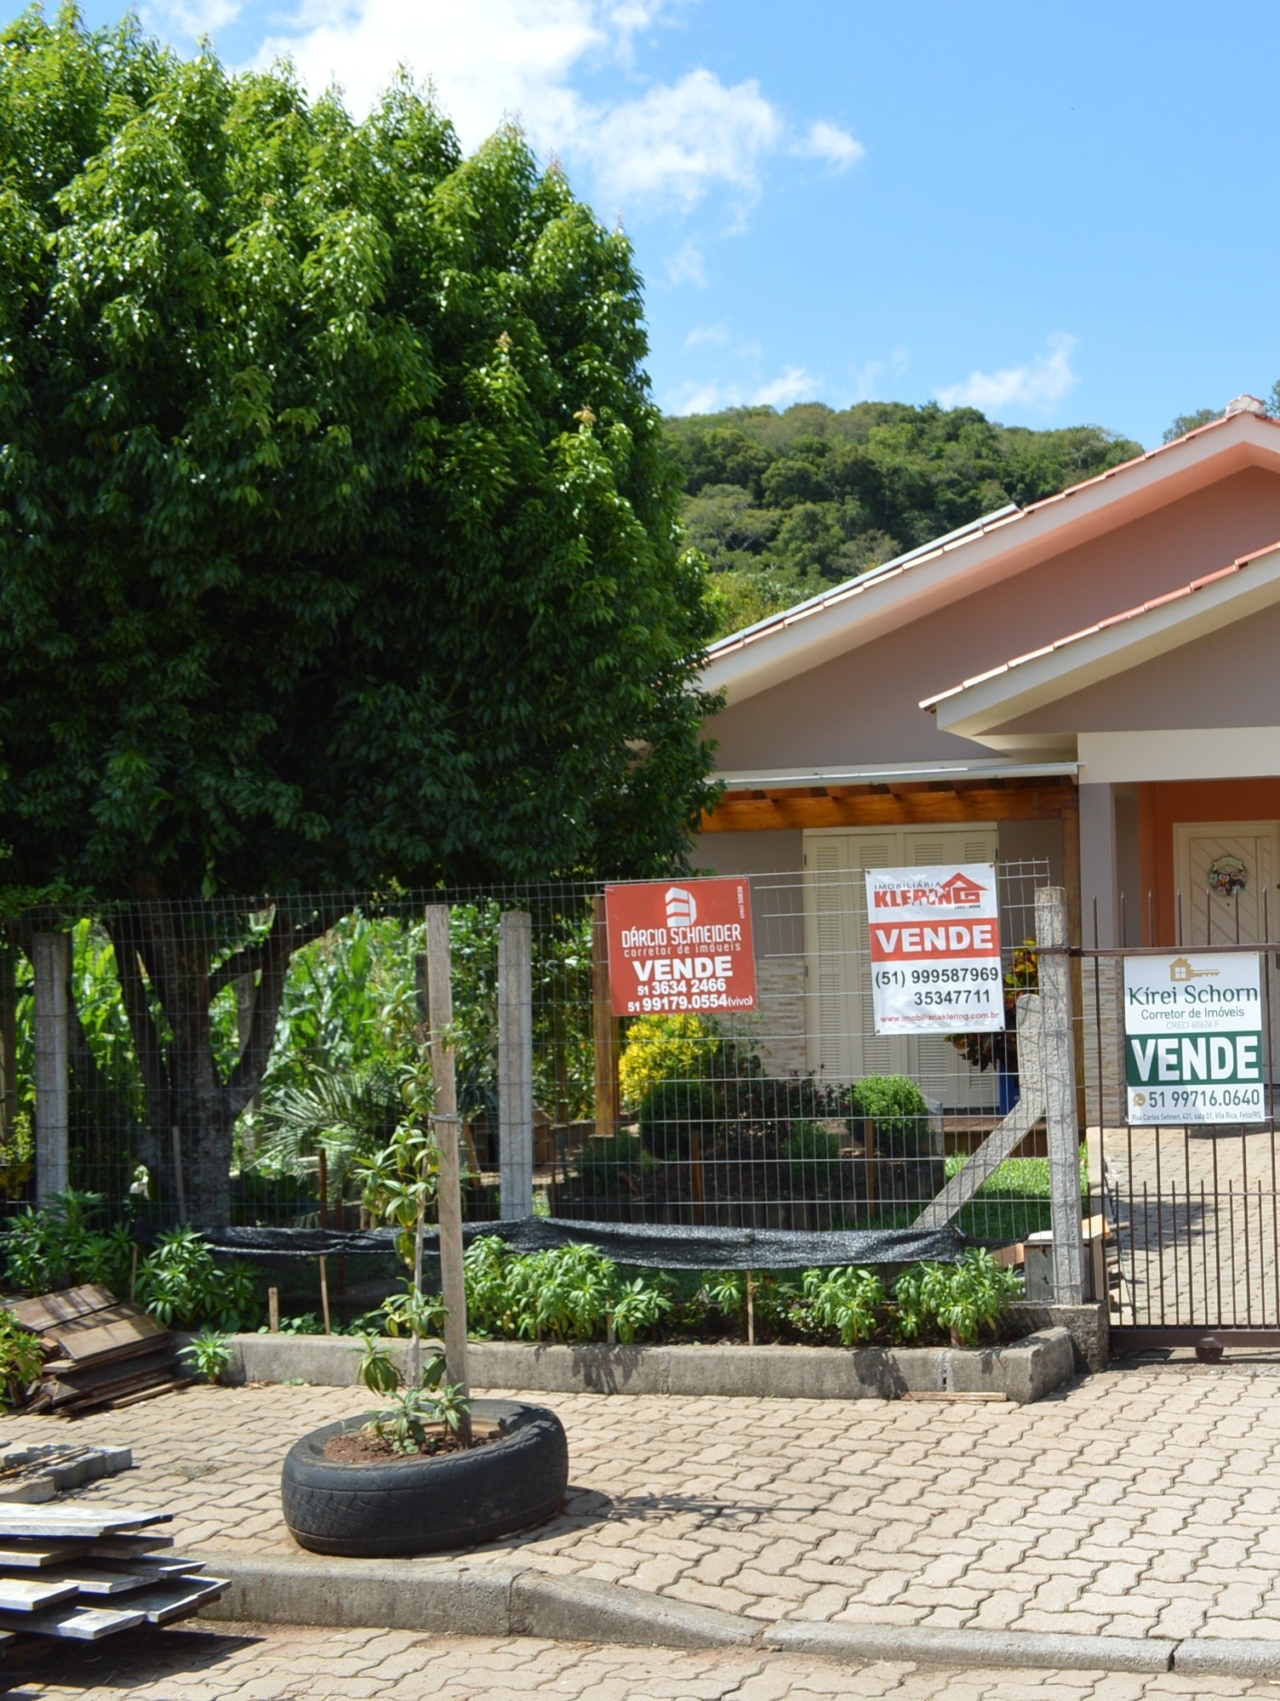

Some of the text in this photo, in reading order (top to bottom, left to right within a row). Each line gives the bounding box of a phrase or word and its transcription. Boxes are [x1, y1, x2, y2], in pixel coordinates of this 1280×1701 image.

[874, 881, 941, 890] IMOBILIÁRIA
[621, 924, 742, 948] DÁRCIO SCHNEIDER
[875, 925, 993, 953] VENDE
[624, 941, 741, 958] corretor de imóveis
[632, 955, 733, 981] VENDE
[875, 967, 998, 989] (51) 999587969
[637, 978, 727, 996] 51 3634 2466
[1128, 984, 1258, 1005] Kírei Schorn
[628, 1001, 640, 1012] 51
[727, 995, 753, 1007] (vivo)
[914, 989, 990, 1005] 35347711
[880, 1012, 999, 1023] www.imobiliariaklering.com.br
[1141, 1006, 1245, 1020] Corretor de Imóveis
[1166, 1021, 1190, 1030] CRECI
[1214, 1020, 1220, 1028] F
[1131, 1035, 1259, 1082] VENDE
[1149, 1088, 1260, 1108] 51 99716.0640
[1143, 1113, 1159, 1121] Carlos
[1194, 1111, 1205, 1120] sala
[1215, 1111, 1225, 1119] Vila
